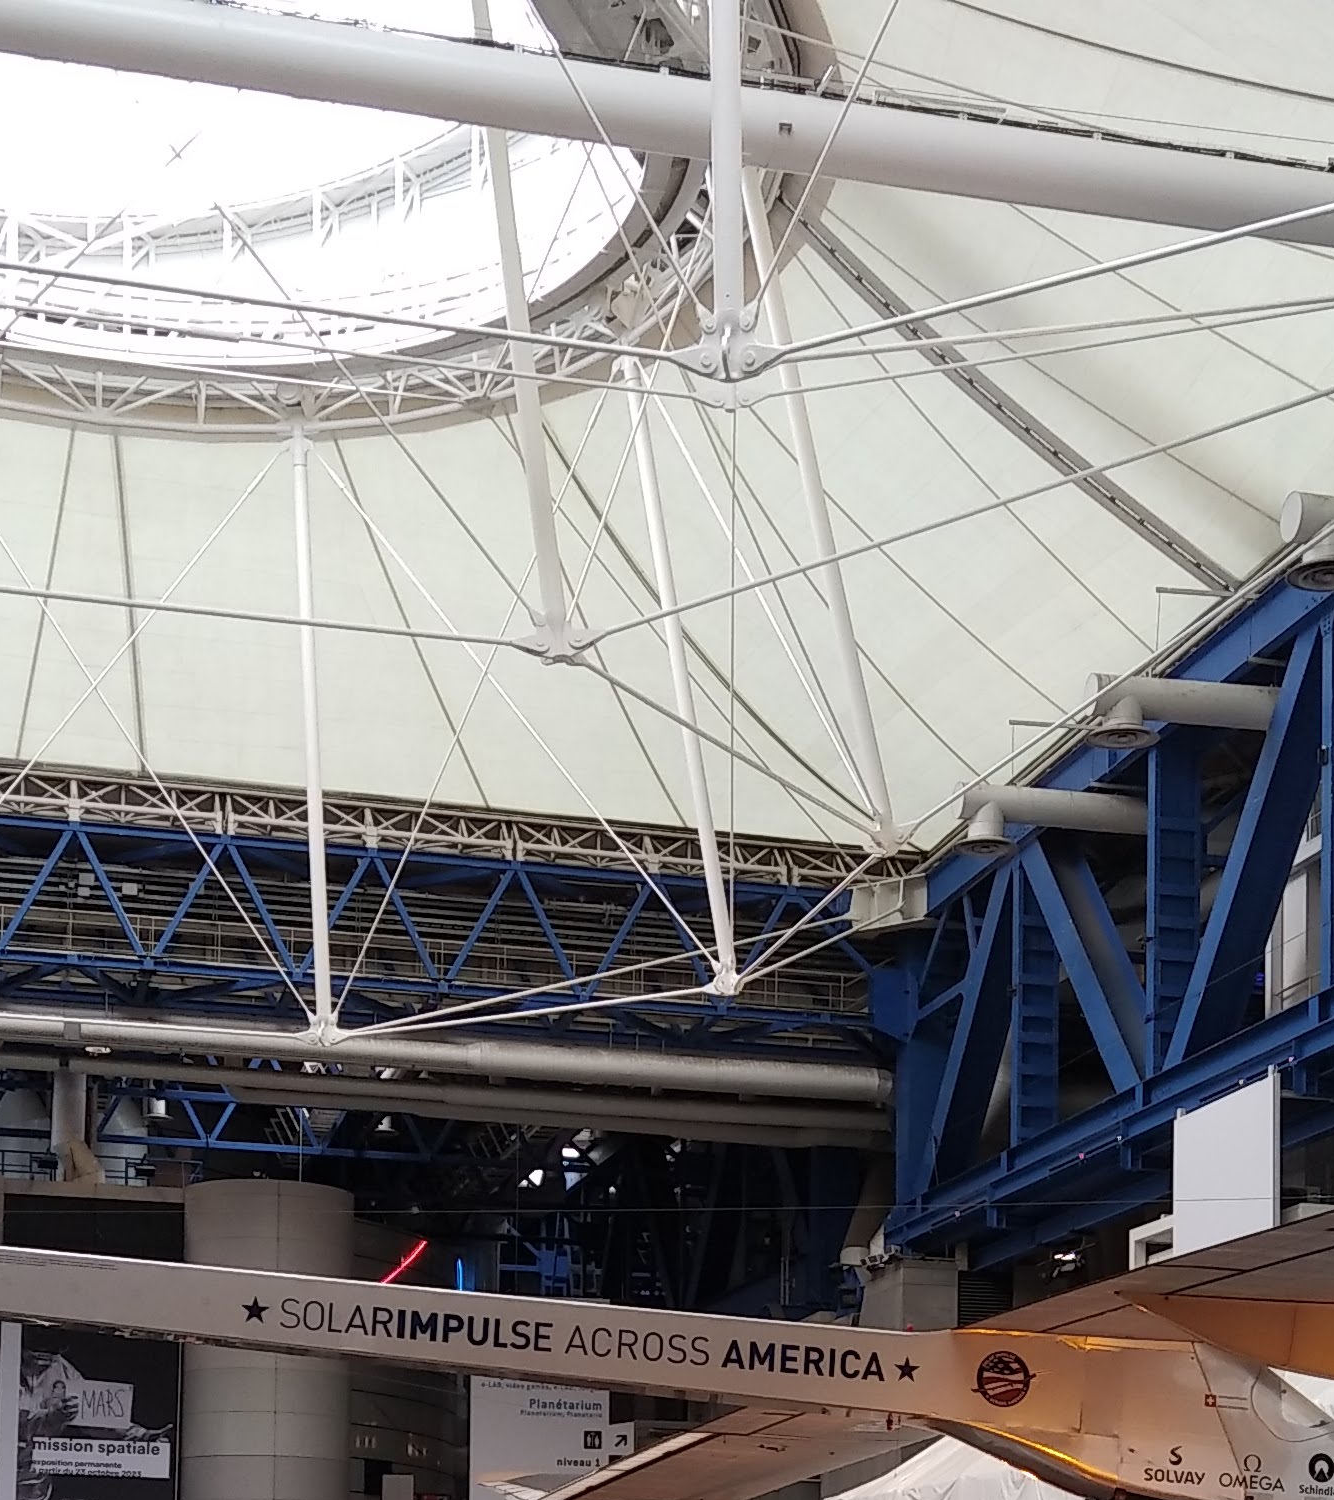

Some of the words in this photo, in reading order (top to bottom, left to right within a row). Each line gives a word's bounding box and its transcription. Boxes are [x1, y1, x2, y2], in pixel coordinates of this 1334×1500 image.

[280, 1298, 554, 1352] SOLARIMPULSE
[566, 1325, 710, 1366] ACROSS
[721, 1339, 886, 1382] AMERICA
[81, 1389, 125, 1419] MARS
[530, 1399, 602, 1411] Planétarium
[33, 1438, 93, 1453] mission
[98, 1441, 160, 1456] spatiale
[75, 1461, 121, 1469] permanente
[557, 1458, 591, 1467] niveau
[595, 1458, 600, 1467] 1
[1144, 1468, 1205, 1485] SOLVAY
[1219, 1472, 1285, 1492] OMEGA
